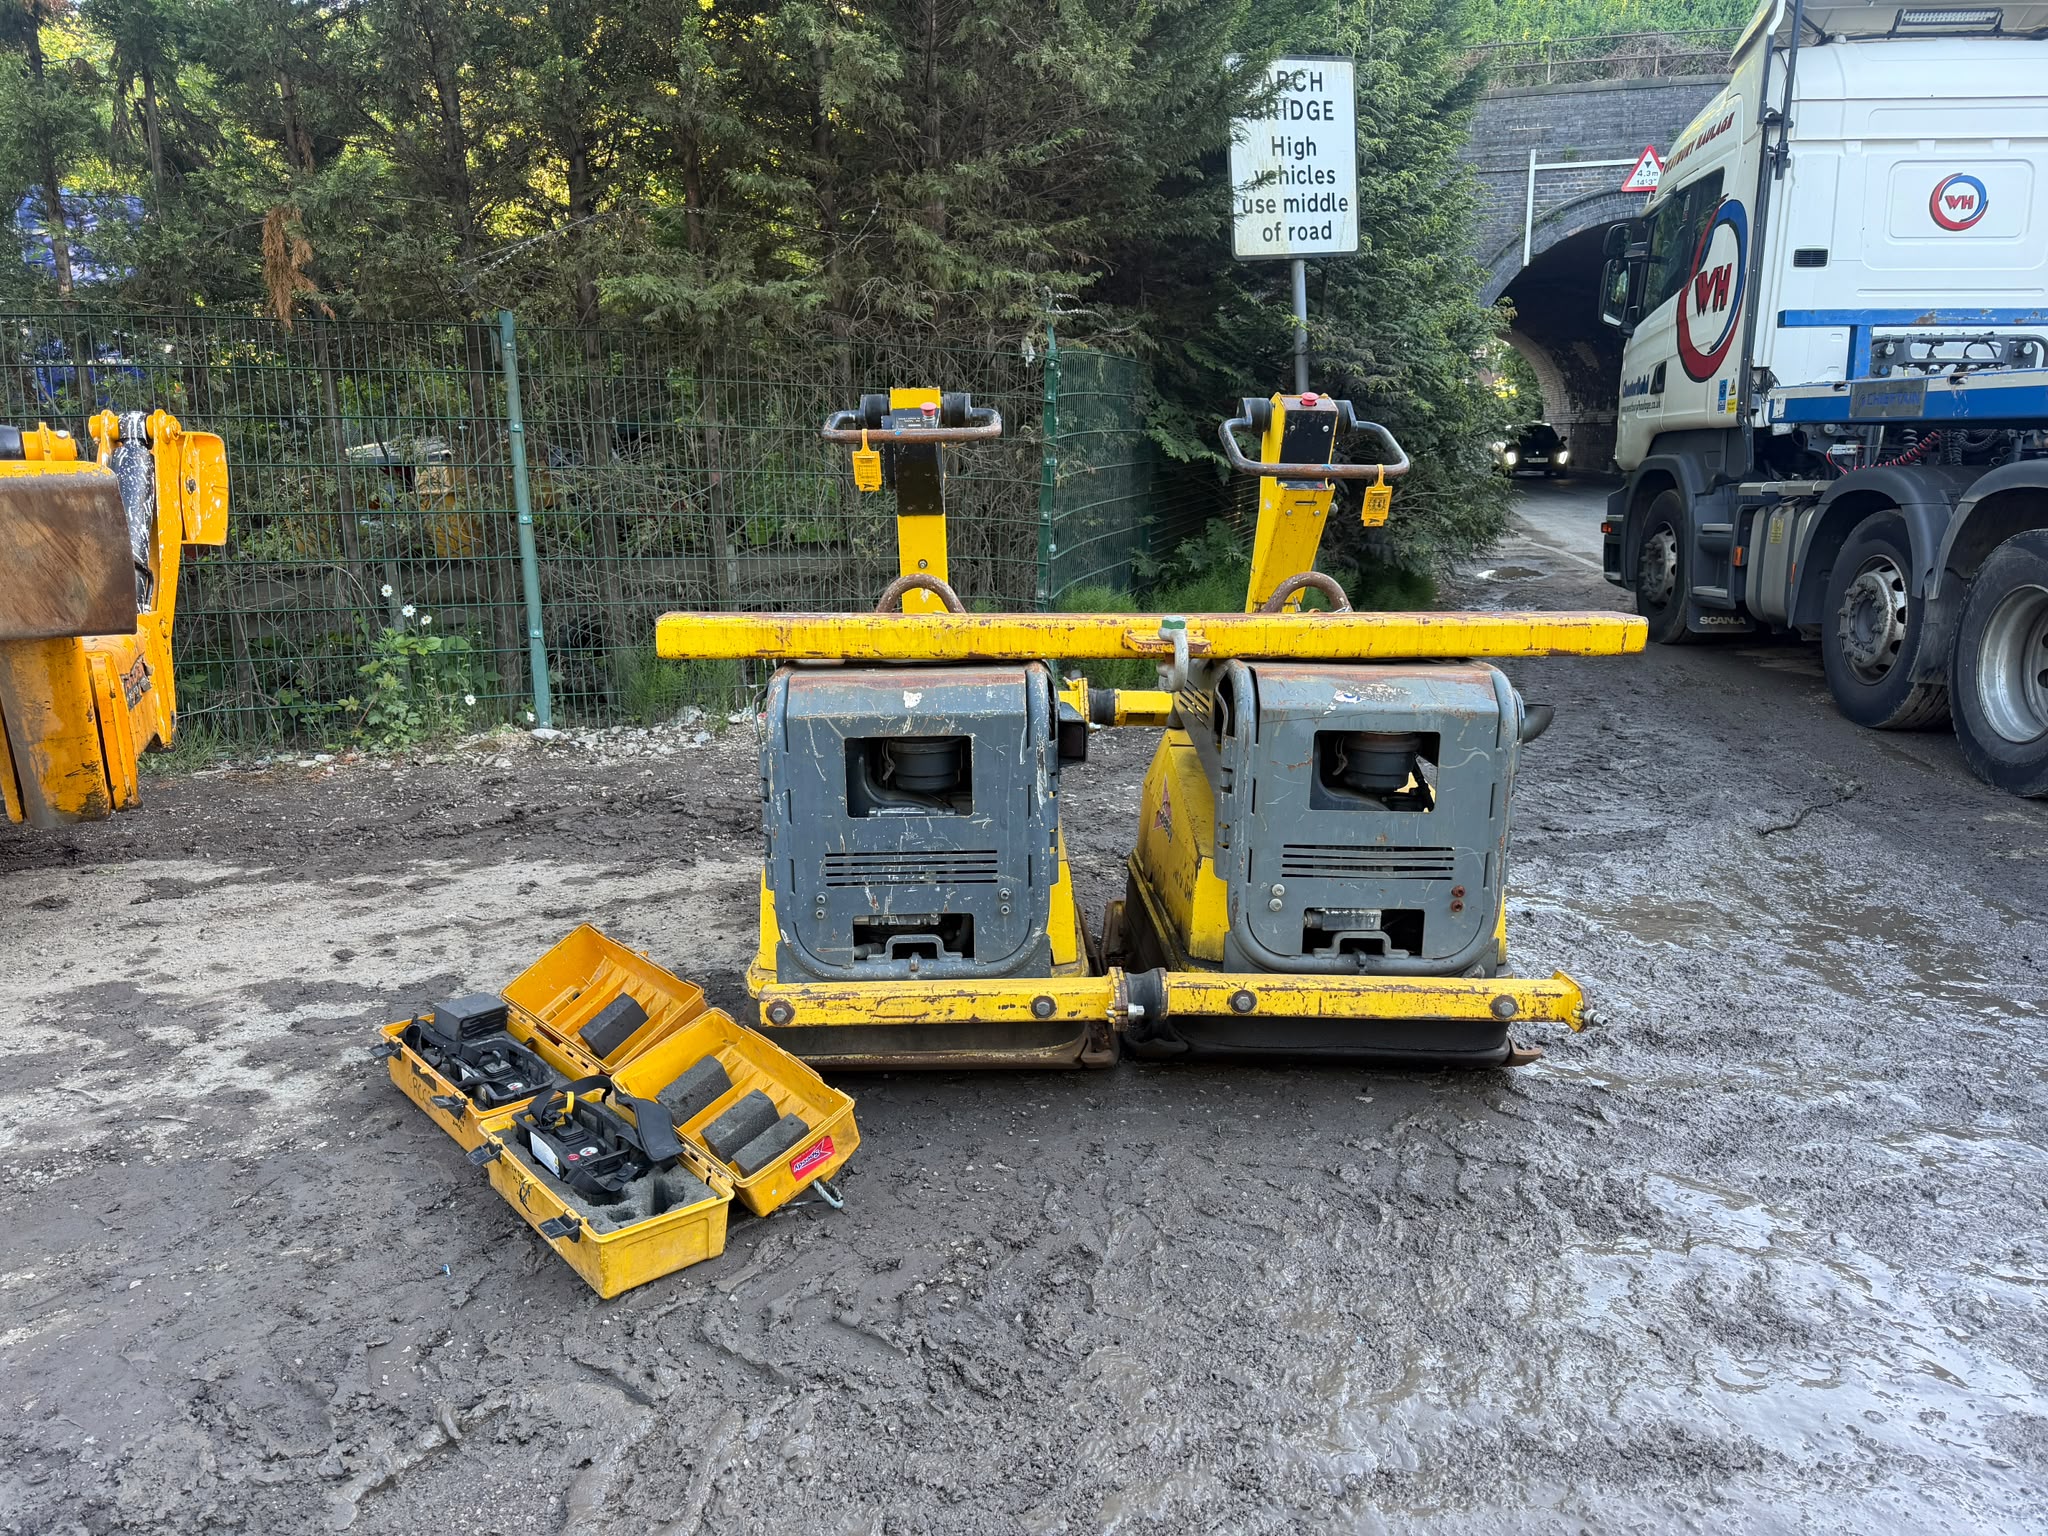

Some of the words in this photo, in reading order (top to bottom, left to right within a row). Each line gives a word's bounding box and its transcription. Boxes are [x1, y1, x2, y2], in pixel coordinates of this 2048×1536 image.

[1271, 136, 1317, 161] High
[1254, 164, 1336, 185] vehicles
[1242, 198, 1276, 214] use
[1283, 192, 1349, 213] middle
[1944, 195, 1975, 210] WH
[1262, 221, 1282, 242] of
[1288, 220, 1333, 241] road
[1694, 262, 1733, 317] WH
